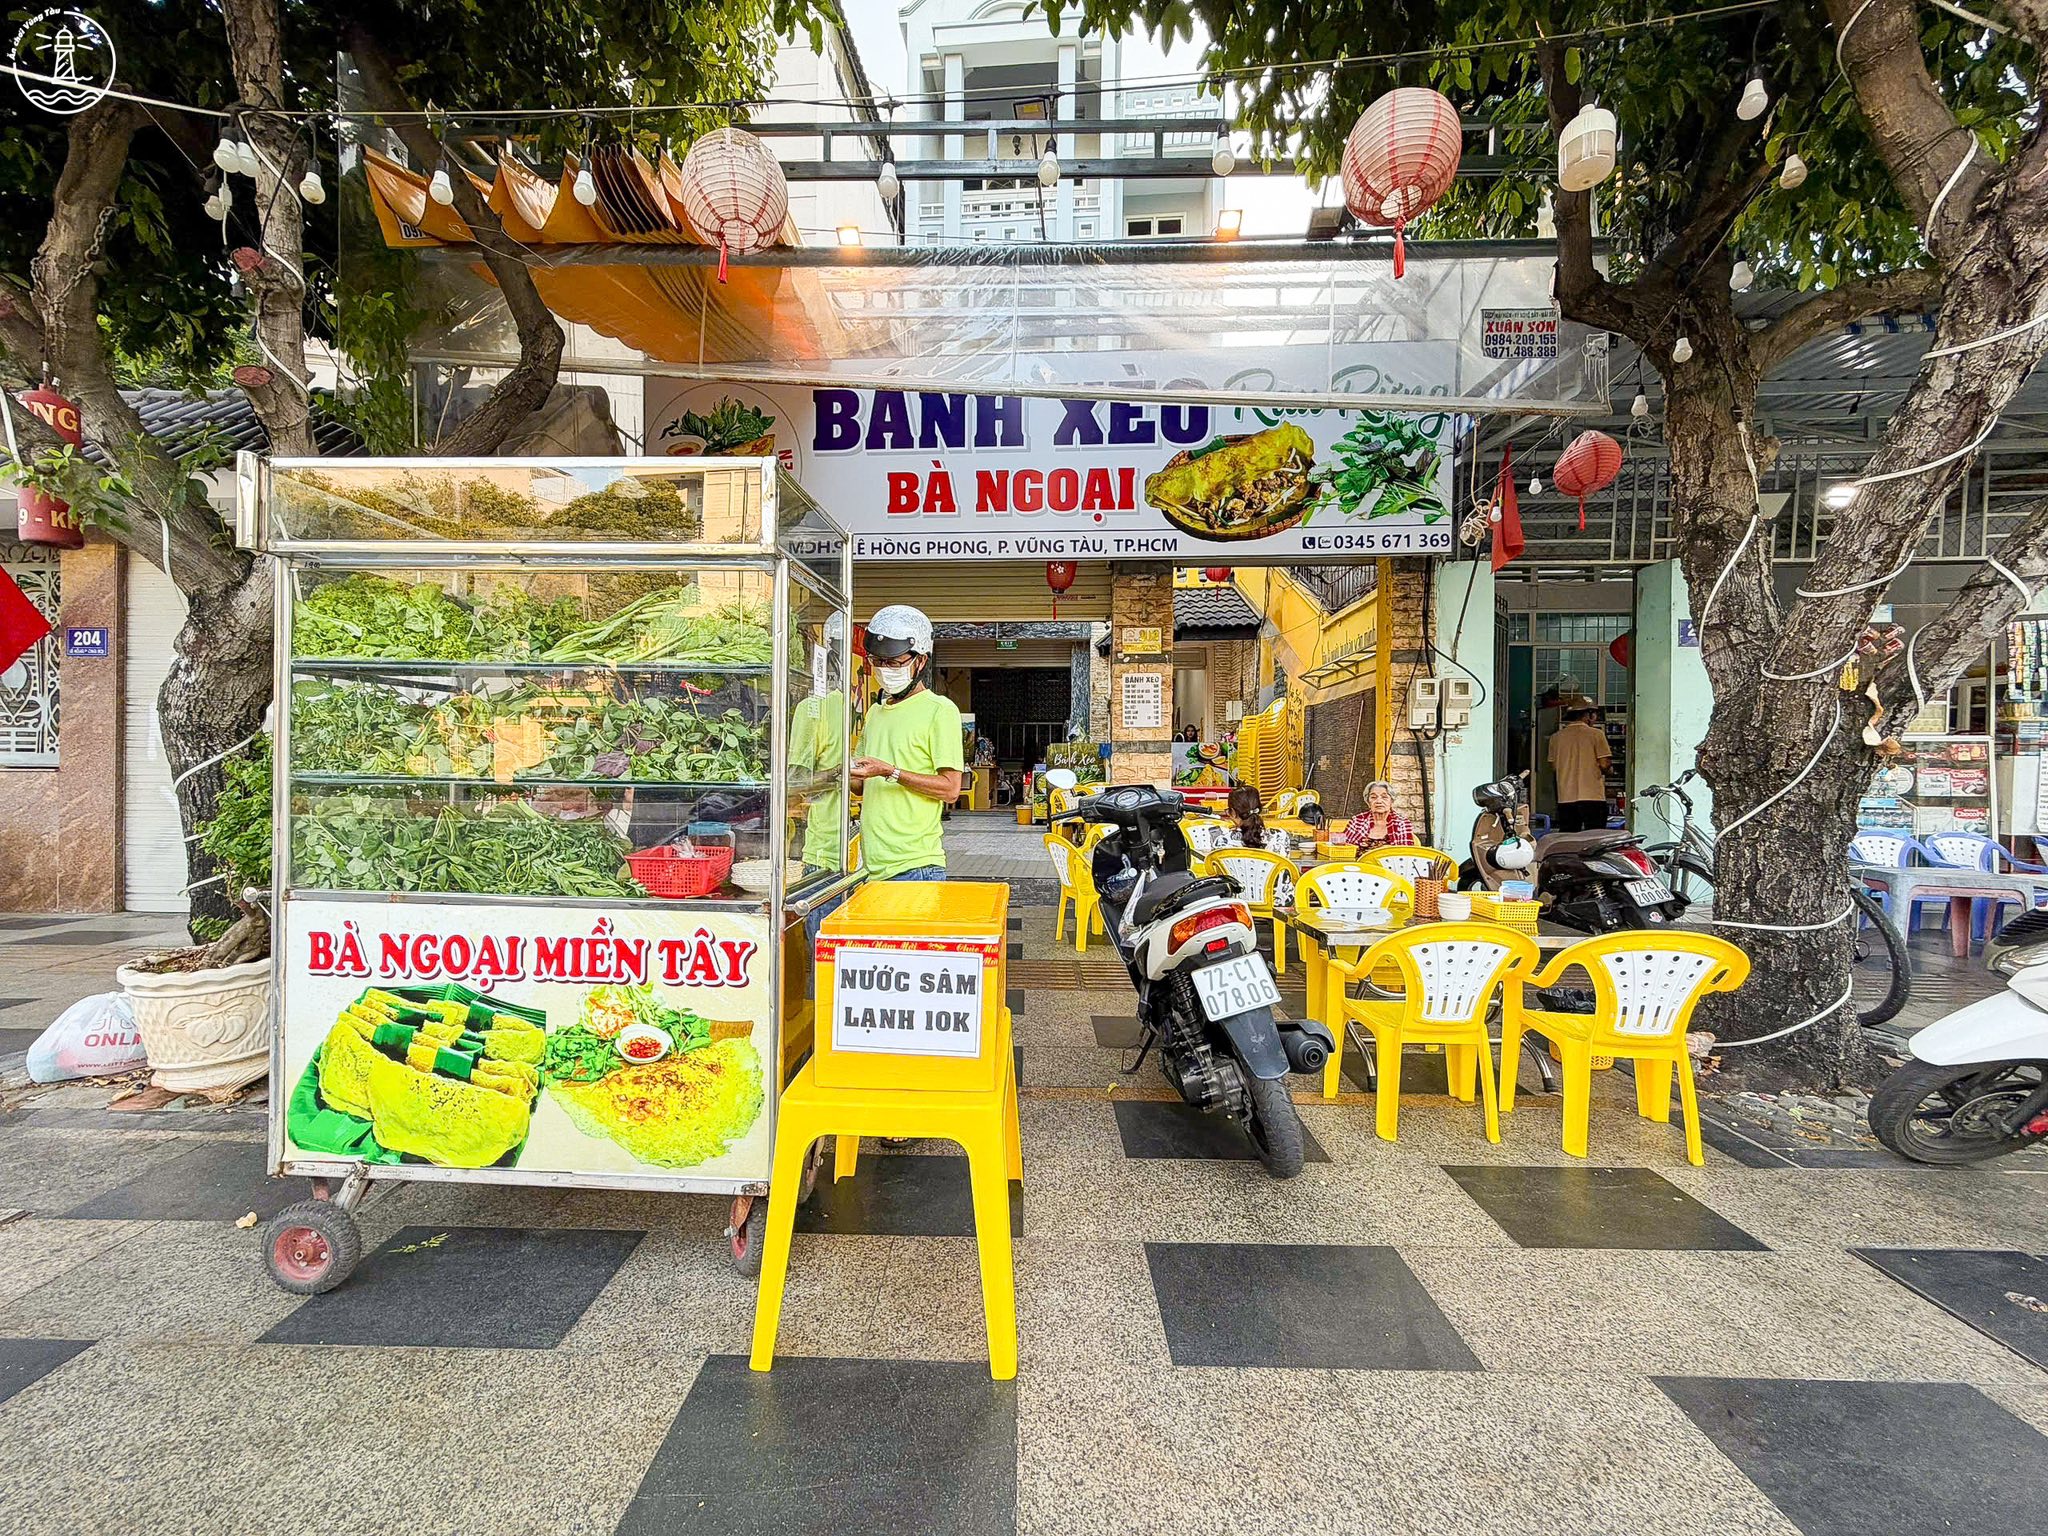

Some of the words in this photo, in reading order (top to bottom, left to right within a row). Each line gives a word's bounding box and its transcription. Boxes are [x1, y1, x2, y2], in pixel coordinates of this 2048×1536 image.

[1485, 318, 1524, 333] XUÂN
[1527, 319, 1557, 333] SƠN
[1485, 333, 1557, 346] 0984.209.155
[1485, 346, 1557, 358] 0971.488.389
[887, 460, 957, 514] BÀ
[976, 466, 1136, 522] NGOẠI
[871, 537, 921, 555] HỒNG
[926, 540, 992, 556] PHONG,
[998, 540, 1010, 554] P.
[1015, 537, 1065, 553] VŨNG
[1070, 536, 1108, 555] TÀU,
[1114, 538, 1178, 552] TP.HCM
[1334, 535, 1375, 549] 0345
[1382, 534, 1411, 548] 671
[1419, 533, 1450, 547] 369
[73, 631, 101, 646] 204
[308, 920, 368, 974] BÀ
[379, 932, 523, 988] NGOẠI
[533, 916, 645, 981] MIỀN
[657, 927, 753, 984] TÂY
[840, 964, 911, 993] NƯỚC
[920, 968, 977, 996] SÂM
[1203, 959, 1257, 991] 72-C1
[1206, 978, 1274, 1015] 078.06
[844, 1006, 915, 1034] LẠNH
